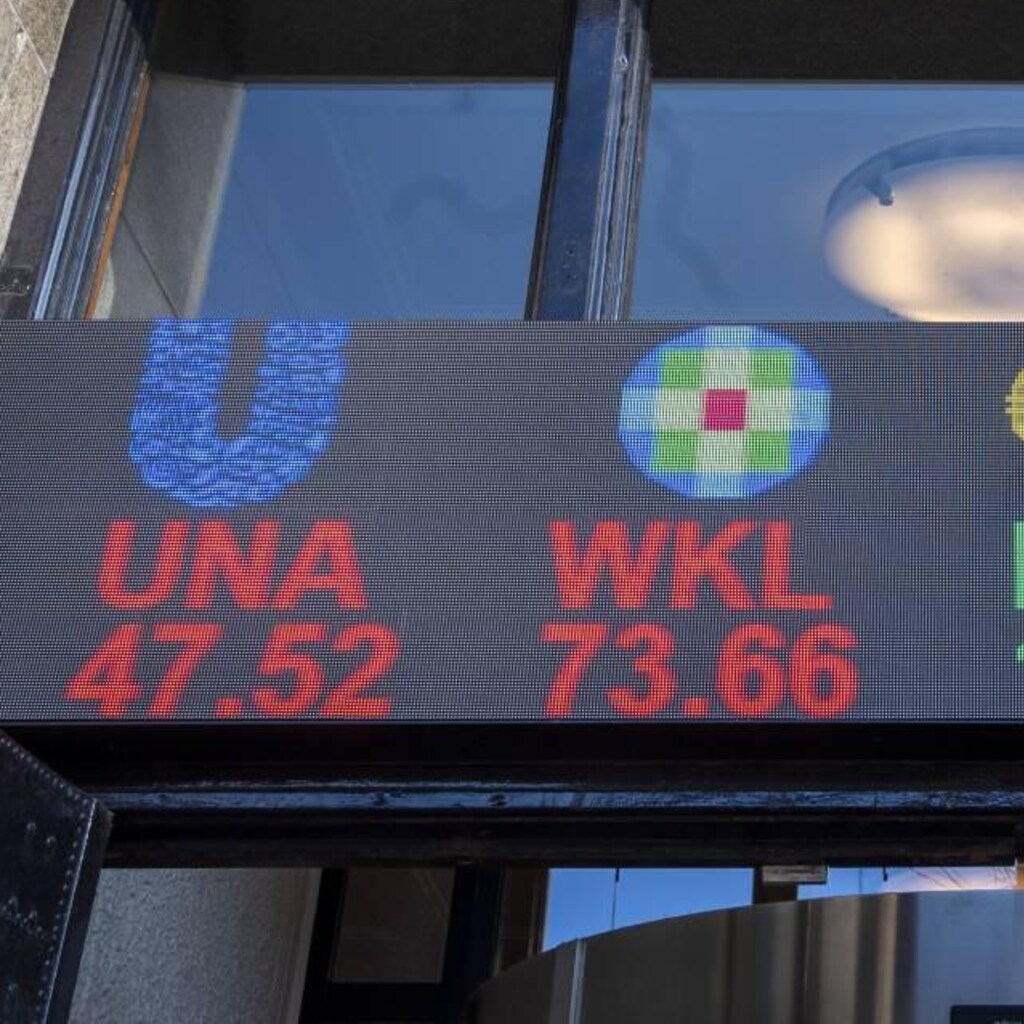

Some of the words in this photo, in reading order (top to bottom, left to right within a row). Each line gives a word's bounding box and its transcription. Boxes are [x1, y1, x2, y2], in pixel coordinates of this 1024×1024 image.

[96, 519, 370, 611] UNA
[548, 519, 835, 611] WKL
[63, 623, 400, 719] 47.52
[540, 623, 860, 719] 73.66
